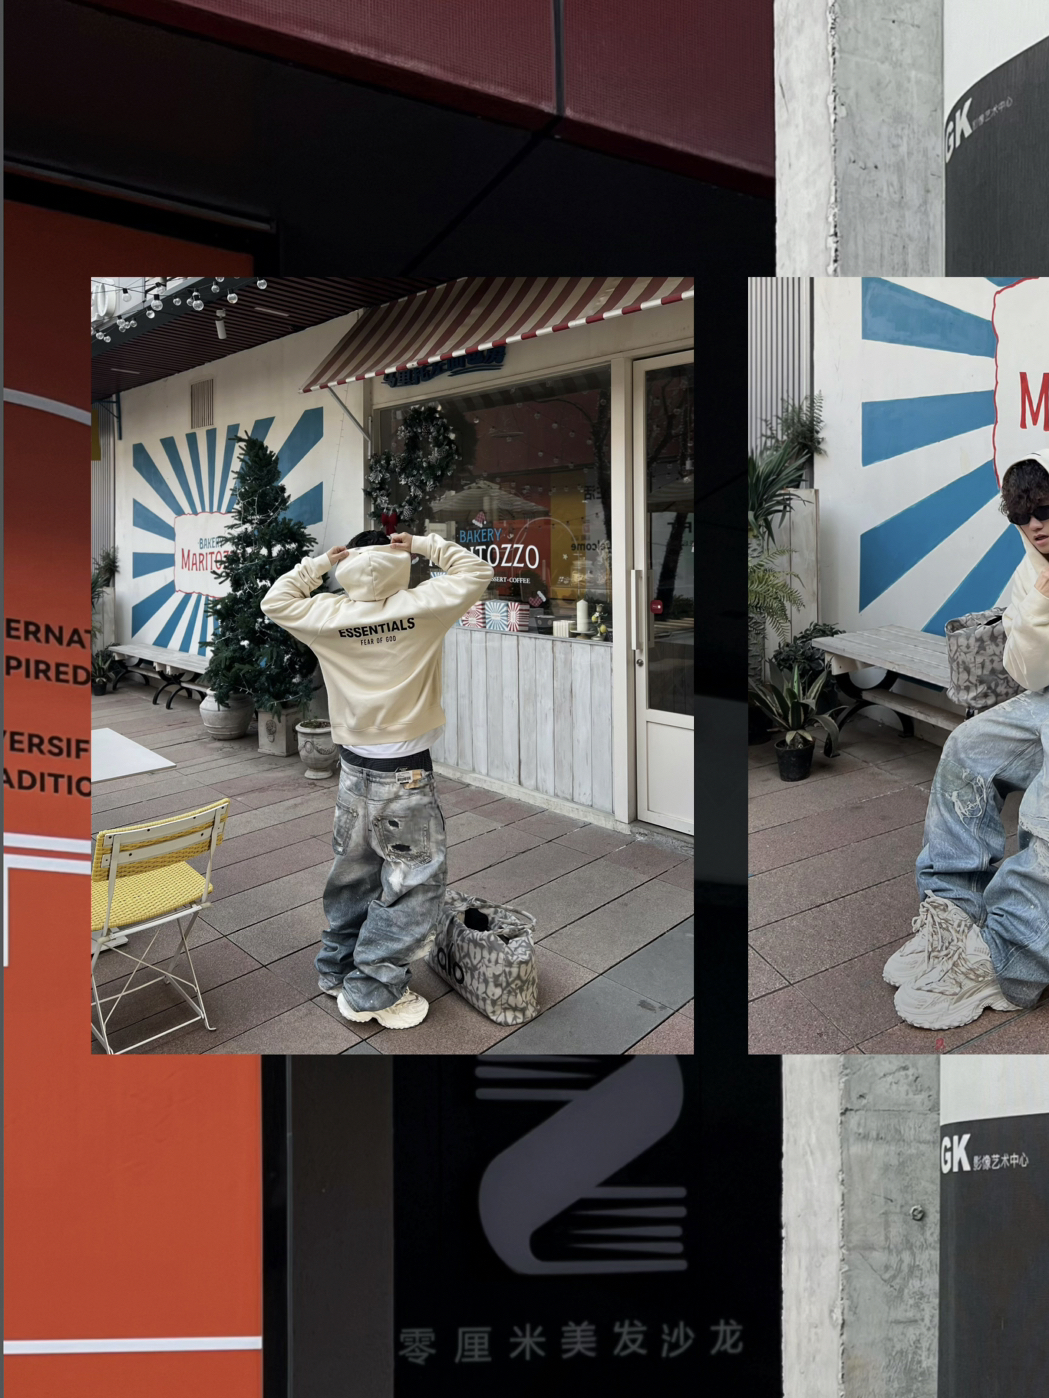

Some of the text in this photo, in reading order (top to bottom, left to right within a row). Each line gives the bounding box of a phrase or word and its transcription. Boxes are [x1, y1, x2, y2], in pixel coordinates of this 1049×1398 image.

[459, 528, 501, 543] BAKERY
[338, 617, 416, 638] ESSENTIALS
[360, 638, 375, 646] FEAR
[385, 635, 397, 643] GOD
[5, 655, 92, 687] PIRED
[940, 1132, 972, 1174] GK
[973, 1151, 1030, 1172] 影像艺术中心
[398, 1317, 745, 1365] 零厘米美发沙龙
